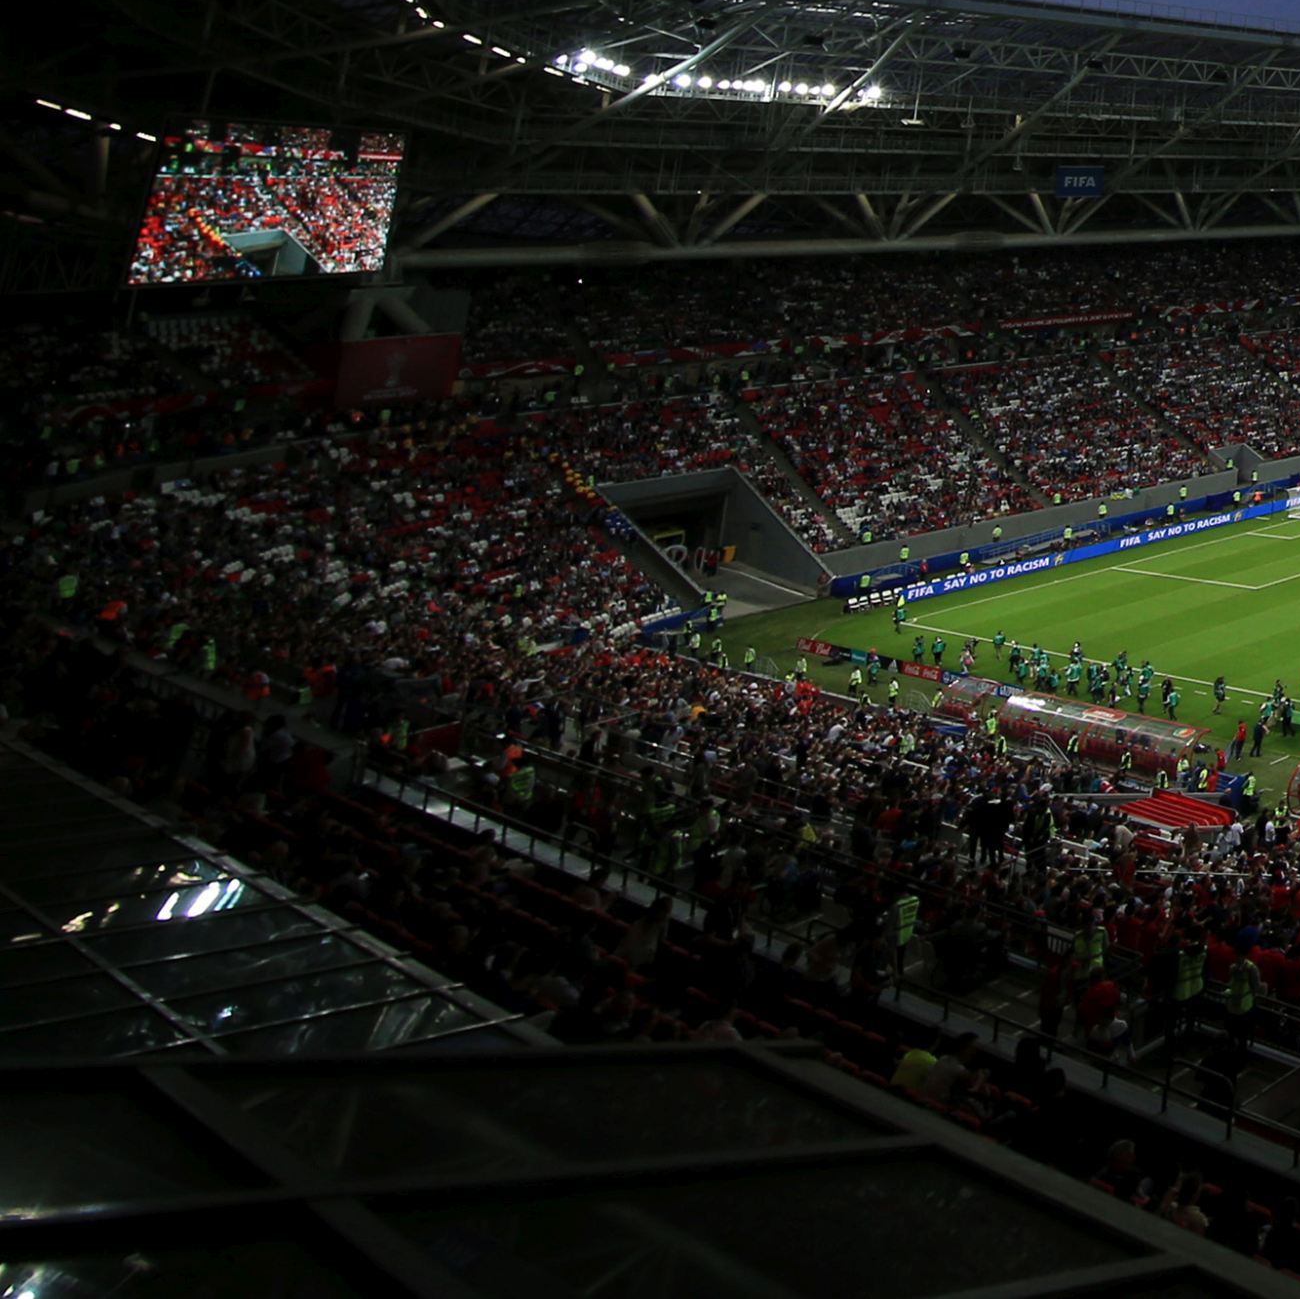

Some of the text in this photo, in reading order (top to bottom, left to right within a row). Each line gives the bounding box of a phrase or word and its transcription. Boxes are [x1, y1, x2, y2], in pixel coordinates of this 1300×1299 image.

[1064, 176, 1096, 187] FIFA
[1120, 514, 1230, 547] FIFA SAY NO TO RACISM
[908, 558, 1049, 599] FIFA SAY NO TO RACISM
